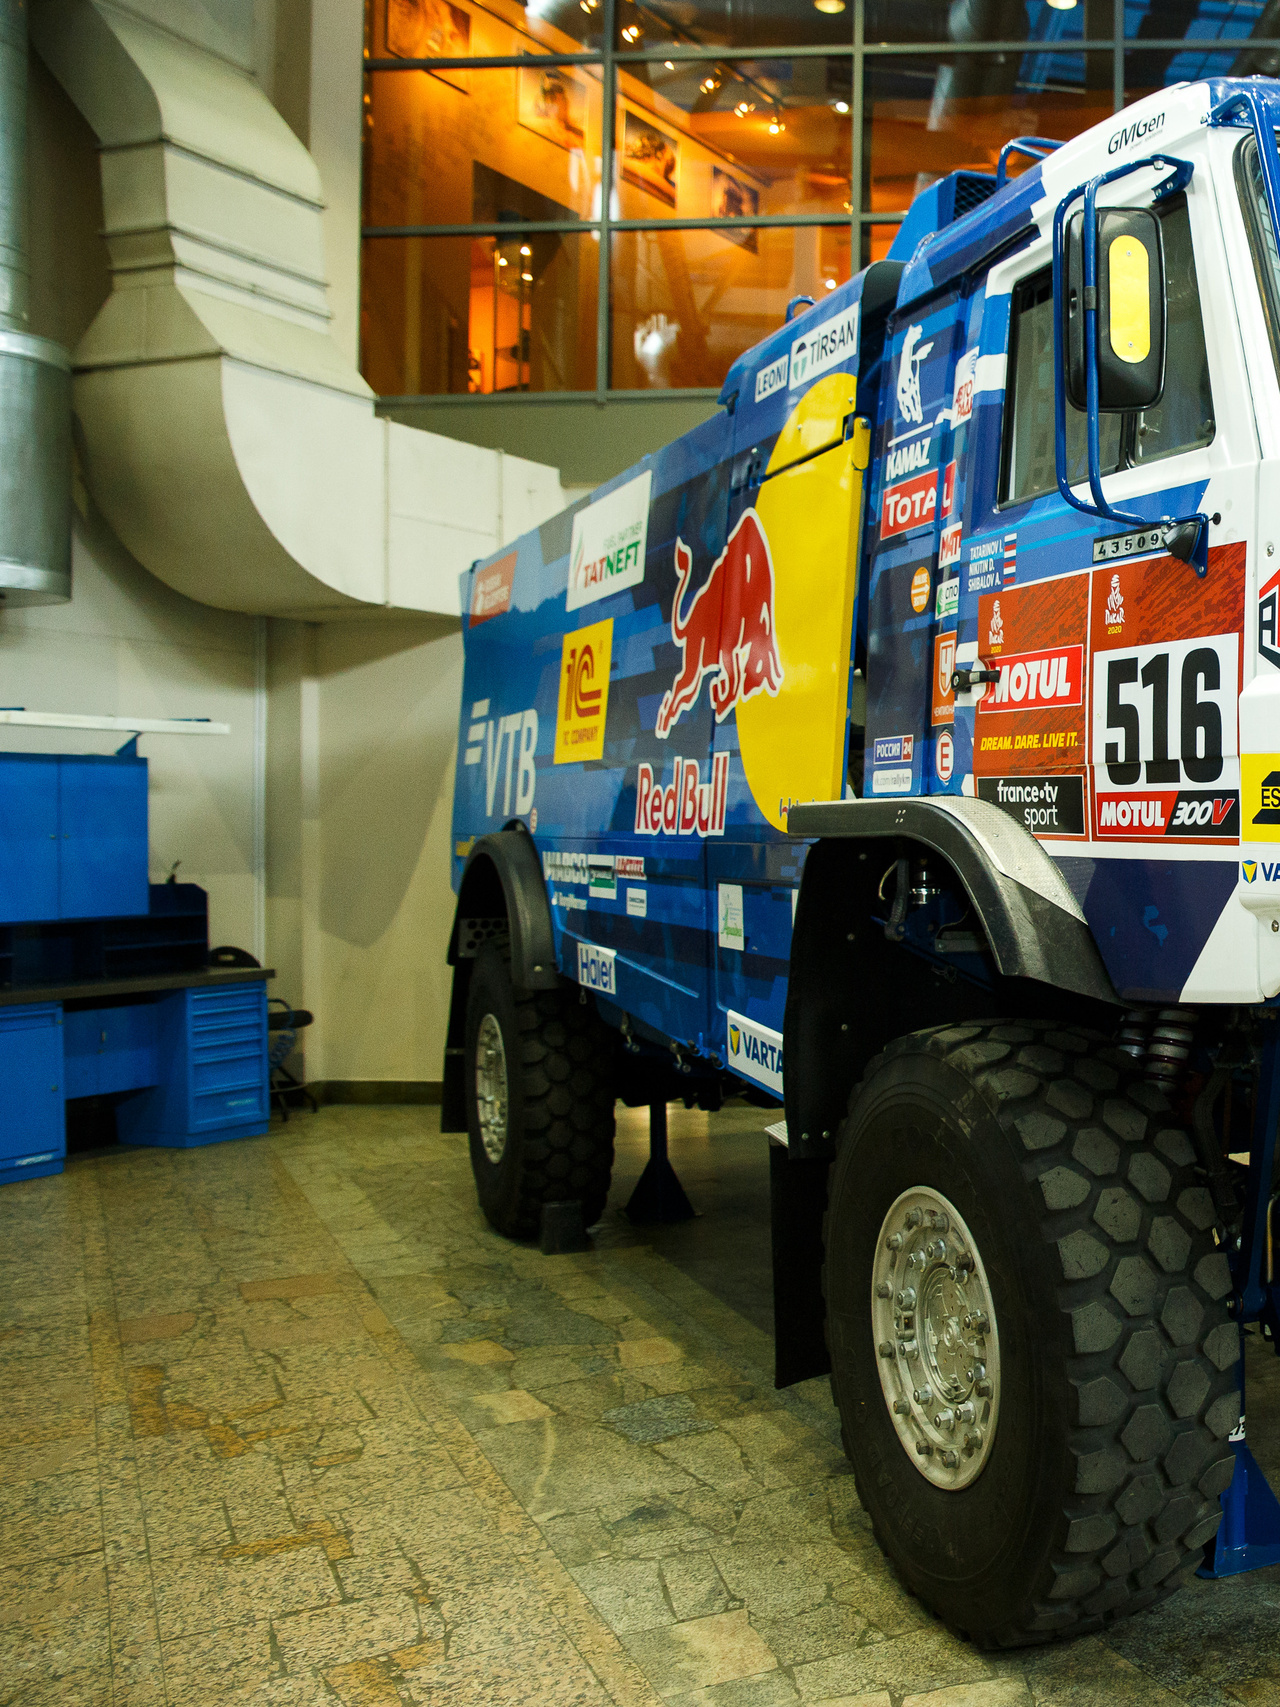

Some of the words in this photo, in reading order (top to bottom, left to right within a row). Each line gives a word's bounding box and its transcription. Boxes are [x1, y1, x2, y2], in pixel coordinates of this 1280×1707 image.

[1108, 112, 1165, 154] GMGen
[757, 360, 787, 396] LEONI
[886, 437, 931, 482] KAMAZ
[885, 482, 951, 528] TOTAL
[584, 540, 641, 588] TATNEFT
[969, 559, 988, 577] NIKITIN
[970, 540, 998, 560] TATARINOV
[968, 574, 994, 592] SHIBALOV
[994, 572, 1002, 586] A.
[1107, 625, 1122, 635] 2020
[990, 645, 1002, 654] 2020
[988, 656, 1071, 704] MOTUL
[1104, 647, 1223, 785] 516
[876, 741, 901, 758] РОССИЯ
[903, 740, 913, 755] 24
[940, 742, 950, 772] E
[980, 734, 1013, 751] DREAM.
[1014, 733, 1041, 749] DARE.
[1043, 732, 1065, 748] LIVE
[1066, 732, 1078, 747] IT.
[485, 708, 539, 817] VTB
[635, 757, 681, 834] Red
[679, 752, 729, 836] Bull
[1024, 805, 1058, 831] sport
[1101, 801, 1165, 827] MOTUL
[1172, 798, 1235, 826] 300V
[580, 948, 612, 990] Haier
[743, 1031, 784, 1074] VARTA
